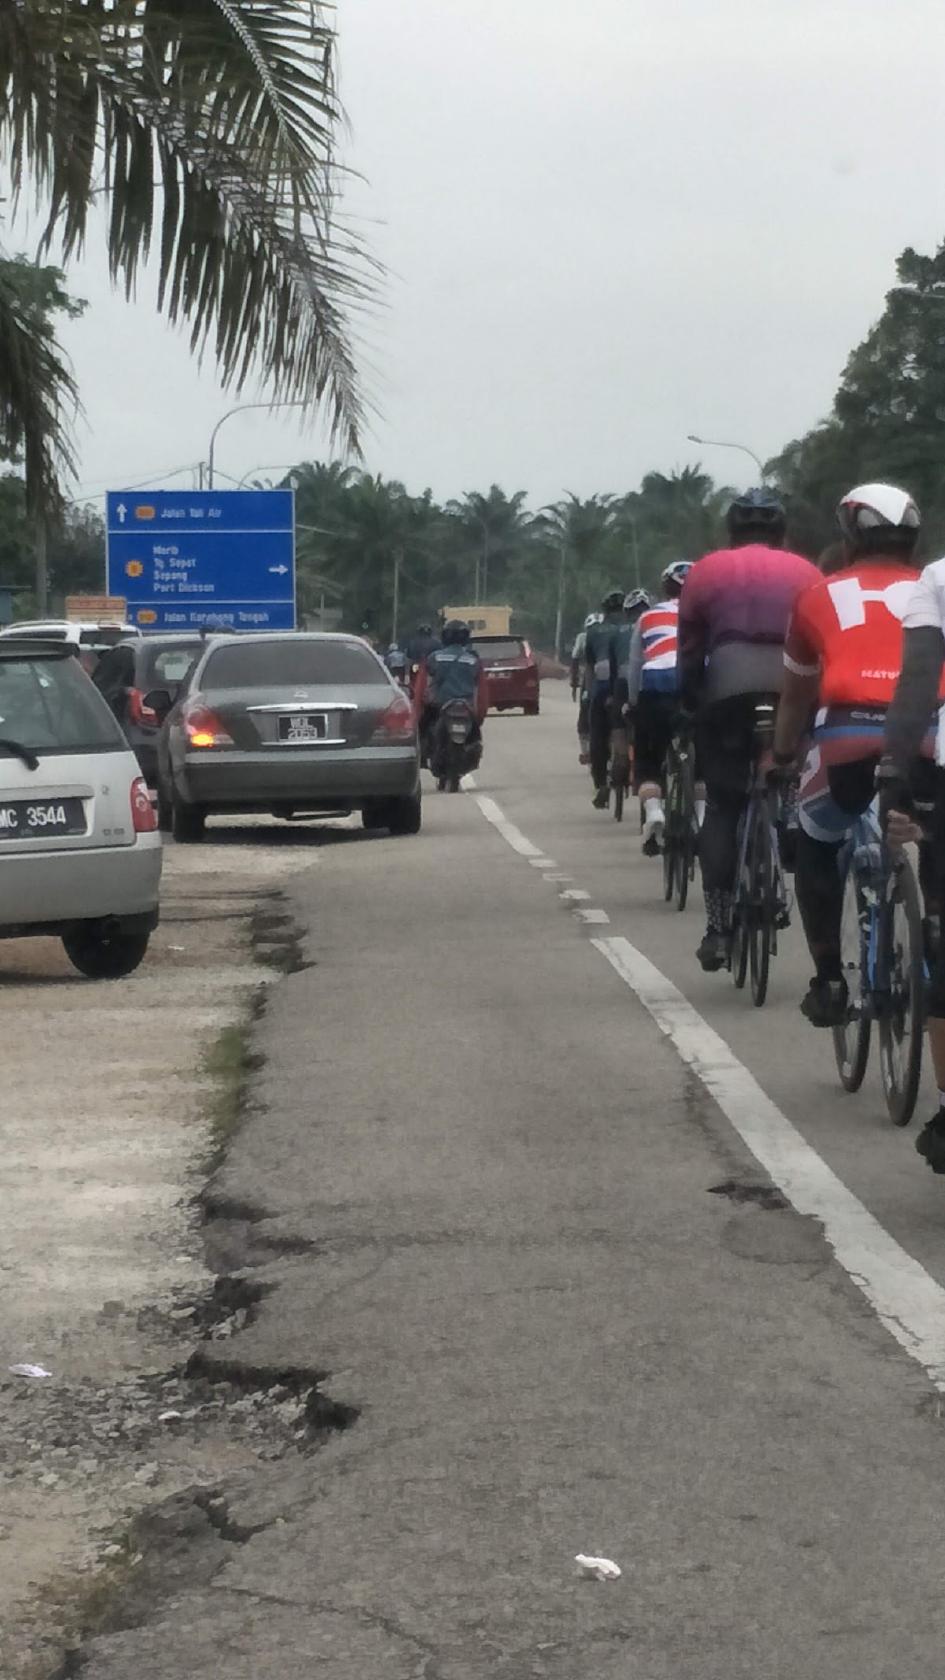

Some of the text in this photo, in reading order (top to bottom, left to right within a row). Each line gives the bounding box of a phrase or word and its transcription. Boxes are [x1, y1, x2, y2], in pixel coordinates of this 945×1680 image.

[161, 508, 185, 518] Jalan
[153, 571, 188, 582] Sepang
[153, 583, 215, 592] Port Dickson
[164, 612, 187, 622] Jalan
[26, 805, 67, 826] 3544
